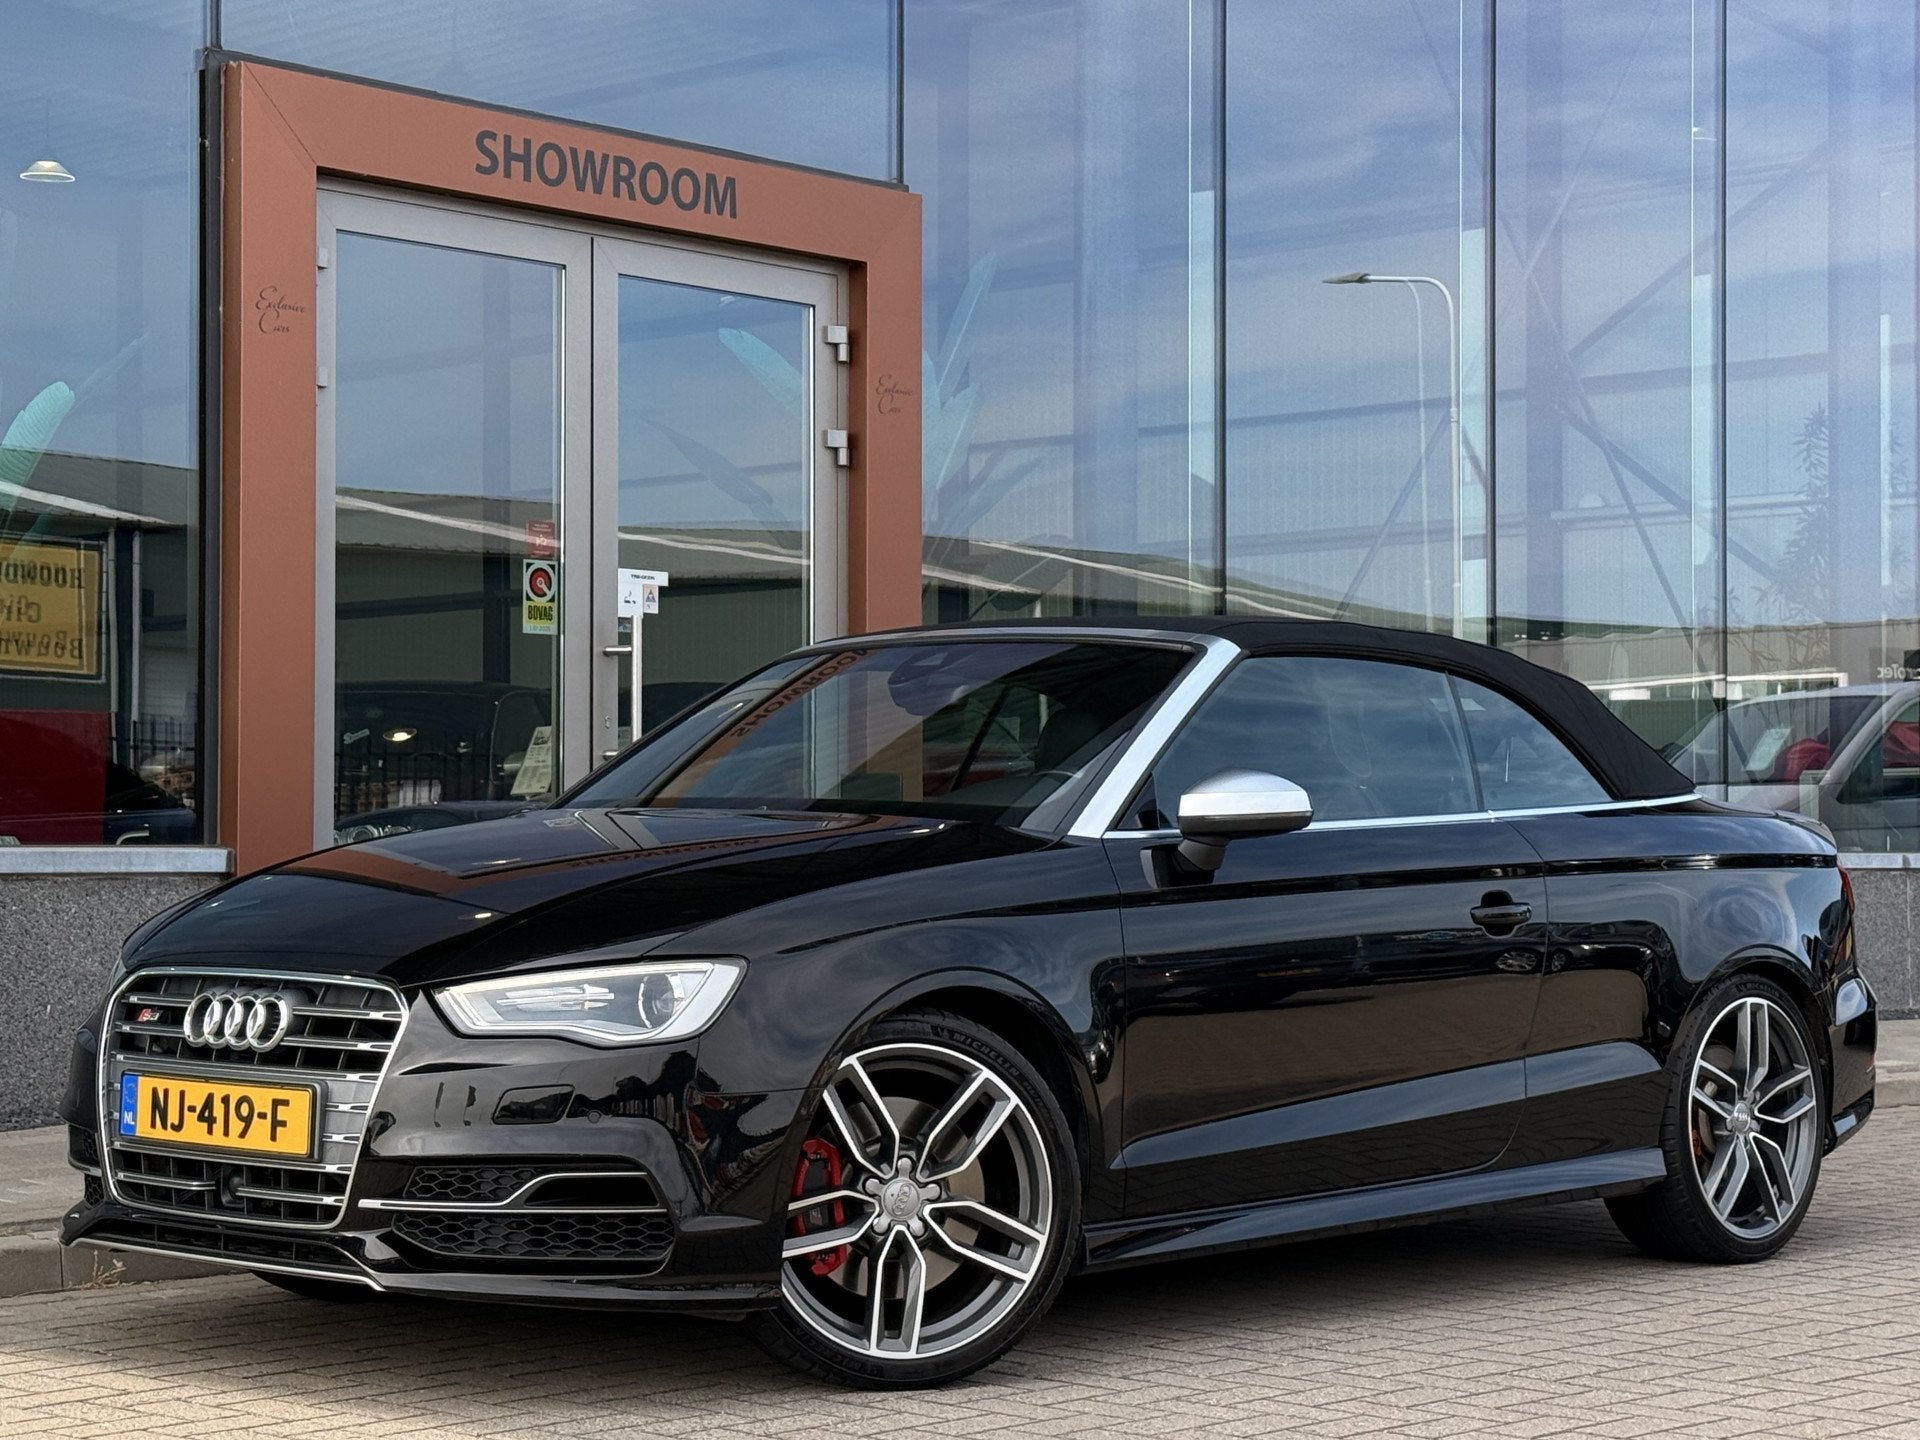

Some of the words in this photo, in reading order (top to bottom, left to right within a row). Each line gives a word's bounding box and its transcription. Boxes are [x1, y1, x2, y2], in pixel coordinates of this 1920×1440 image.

[475, 130, 737, 219] SHOWROOM
[255, 286, 306, 314] Exclusive
[528, 605, 554, 622] BOVAG
[952, 1032, 1020, 1077] MICHELIN
[124, 1110, 135, 1125] NL
[150, 1086, 290, 1142] NJ-419-F
